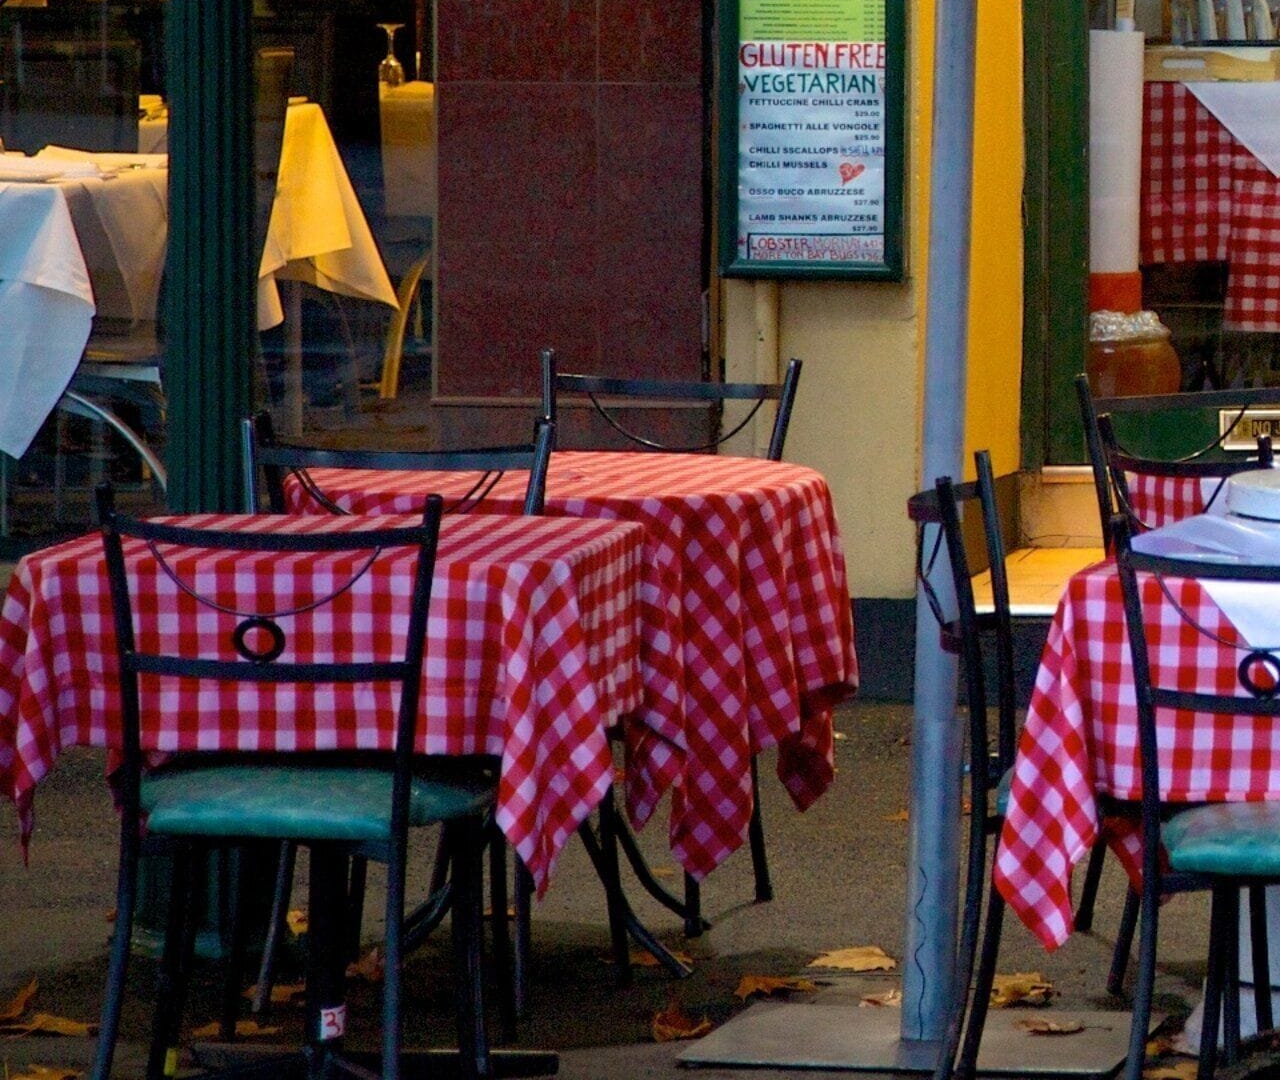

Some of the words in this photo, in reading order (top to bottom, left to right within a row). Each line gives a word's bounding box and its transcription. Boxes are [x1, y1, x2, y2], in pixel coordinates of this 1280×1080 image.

[740, 43, 829, 68] GLUTEN
[835, 43, 886, 68] FREE
[744, 73, 876, 94] VEGETARIAN
[749, 98, 808, 106] FETTUCCINE
[812, 98, 844, 106] CHILLI
[846, 99, 880, 107] CRABS
[749, 123, 802, 131] SPAGHETTI
[832, 123, 880, 131] VONGOLE
[749, 146, 780, 154] CHILLI
[783, 146, 838, 154] SSCALLOPS
[749, 161, 780, 169] CHILLI
[783, 161, 828, 169] MUSSELS
[749, 188, 775, 196] OSSO
[778, 188, 804, 196] BUCO
[807, 188, 865, 196] ABRUZZESE
